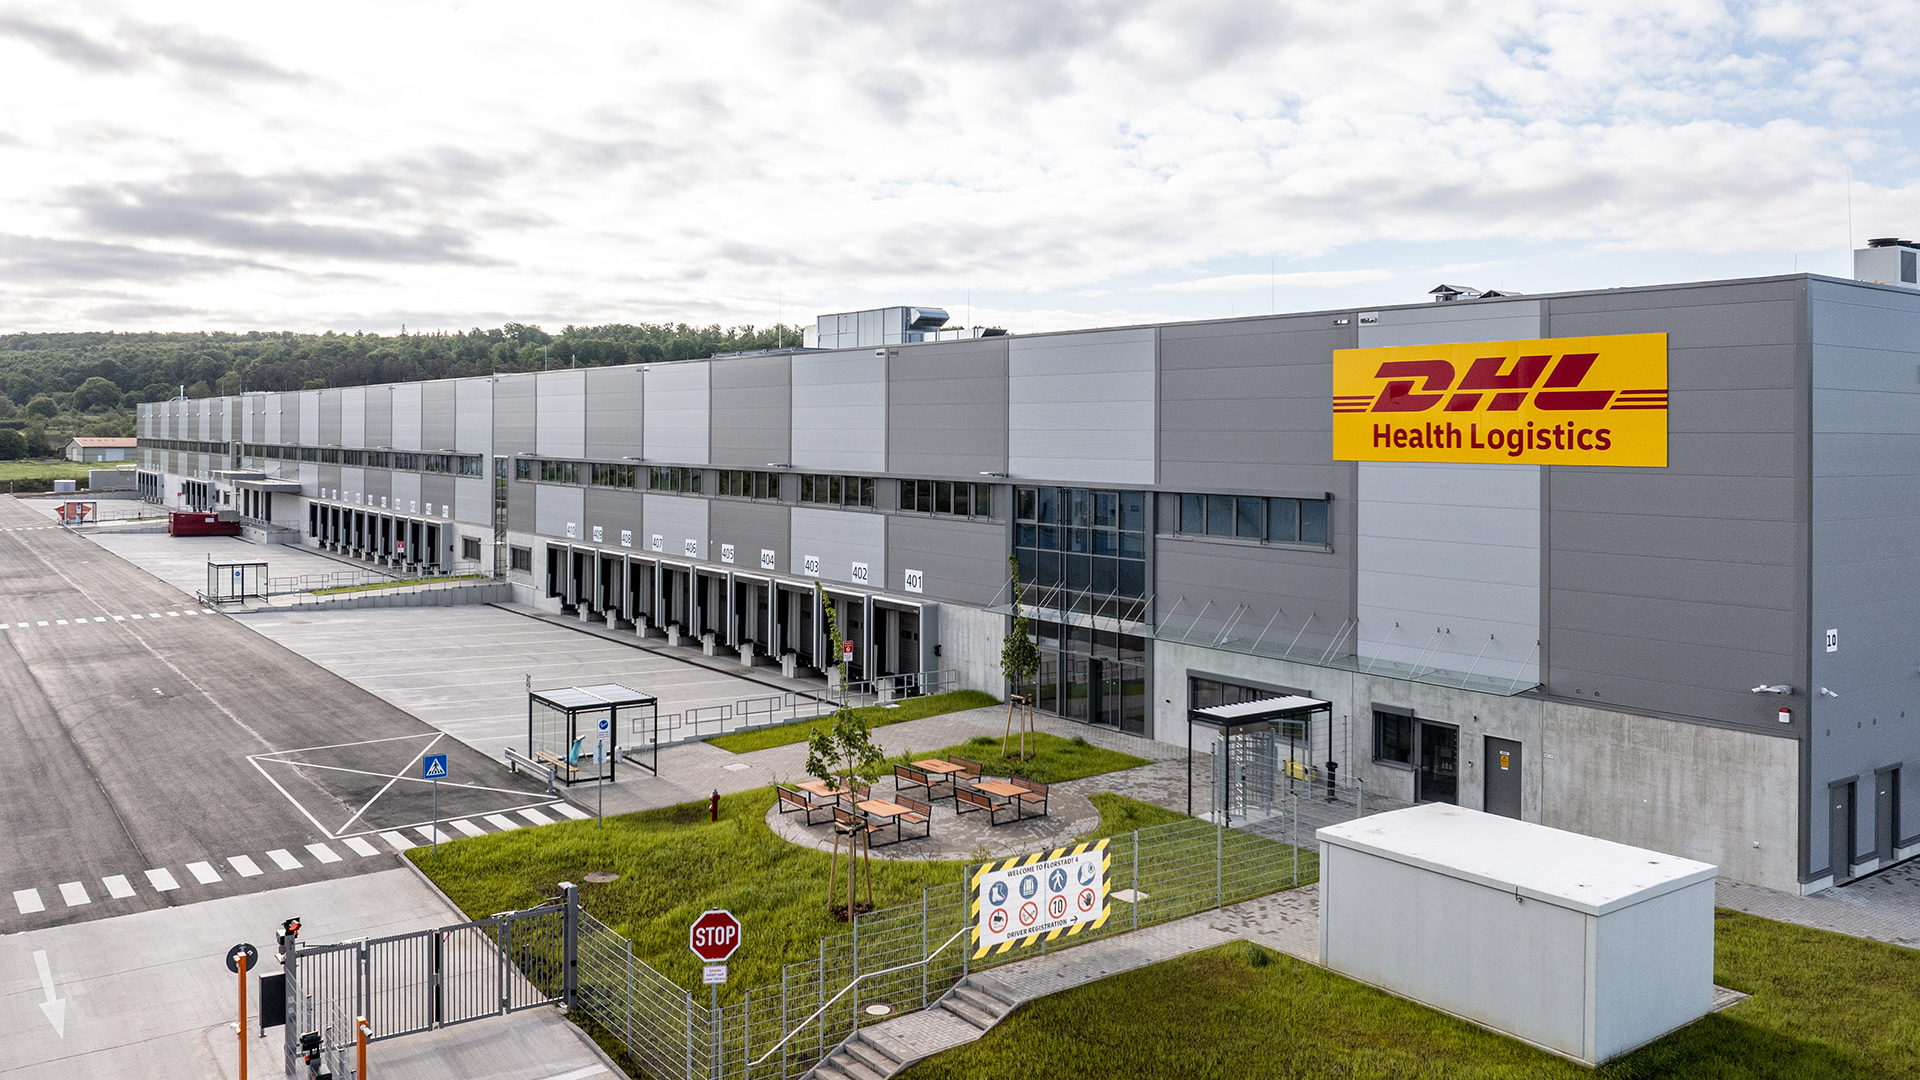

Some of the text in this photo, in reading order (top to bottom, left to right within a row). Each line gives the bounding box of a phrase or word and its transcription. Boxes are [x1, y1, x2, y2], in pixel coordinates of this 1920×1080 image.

[1371, 353, 1615, 412] DHL
[1373, 421, 1612, 457] Health Logistics
[652, 537, 662, 549] 407
[685, 541, 697, 554] 406
[721, 548, 734, 560] 405
[761, 553, 774, 566] 404
[805, 560, 819, 573] 403
[852, 566, 868, 580] 402
[906, 574, 922, 588] 401
[1827, 634, 1836, 647] 10
[1007, 866, 1035, 877] WELCOME
[1044, 858, 1074, 869] FLORSTADT
[1053, 899, 1063, 914] 10
[695, 925, 736, 947] STOP
[1007, 919, 1067, 939] DRIVER REGISTRATION
